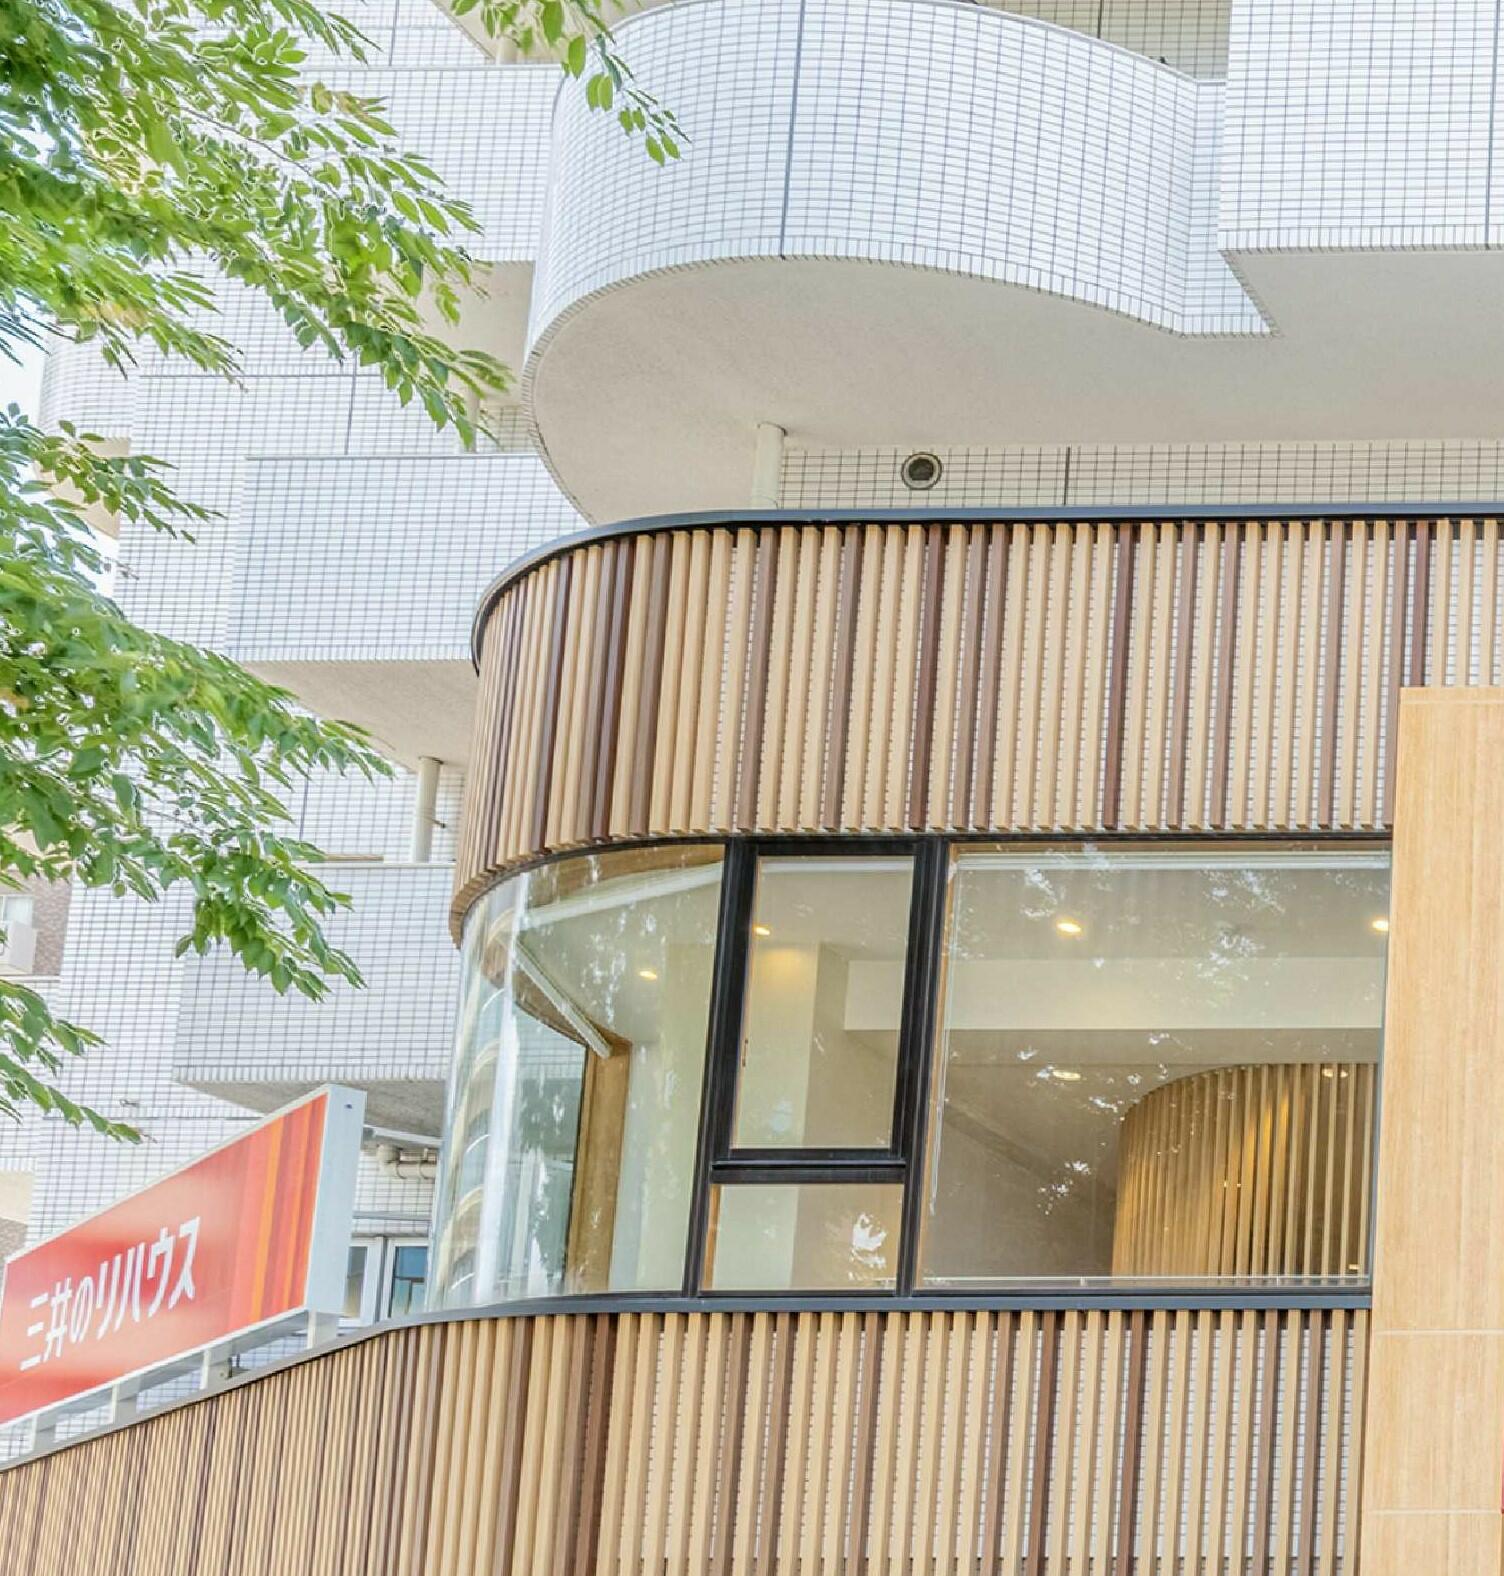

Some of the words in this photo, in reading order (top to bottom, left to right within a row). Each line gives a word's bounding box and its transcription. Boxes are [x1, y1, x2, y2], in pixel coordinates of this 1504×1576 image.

[20, 1216, 201, 1371] 三井のリハウス
